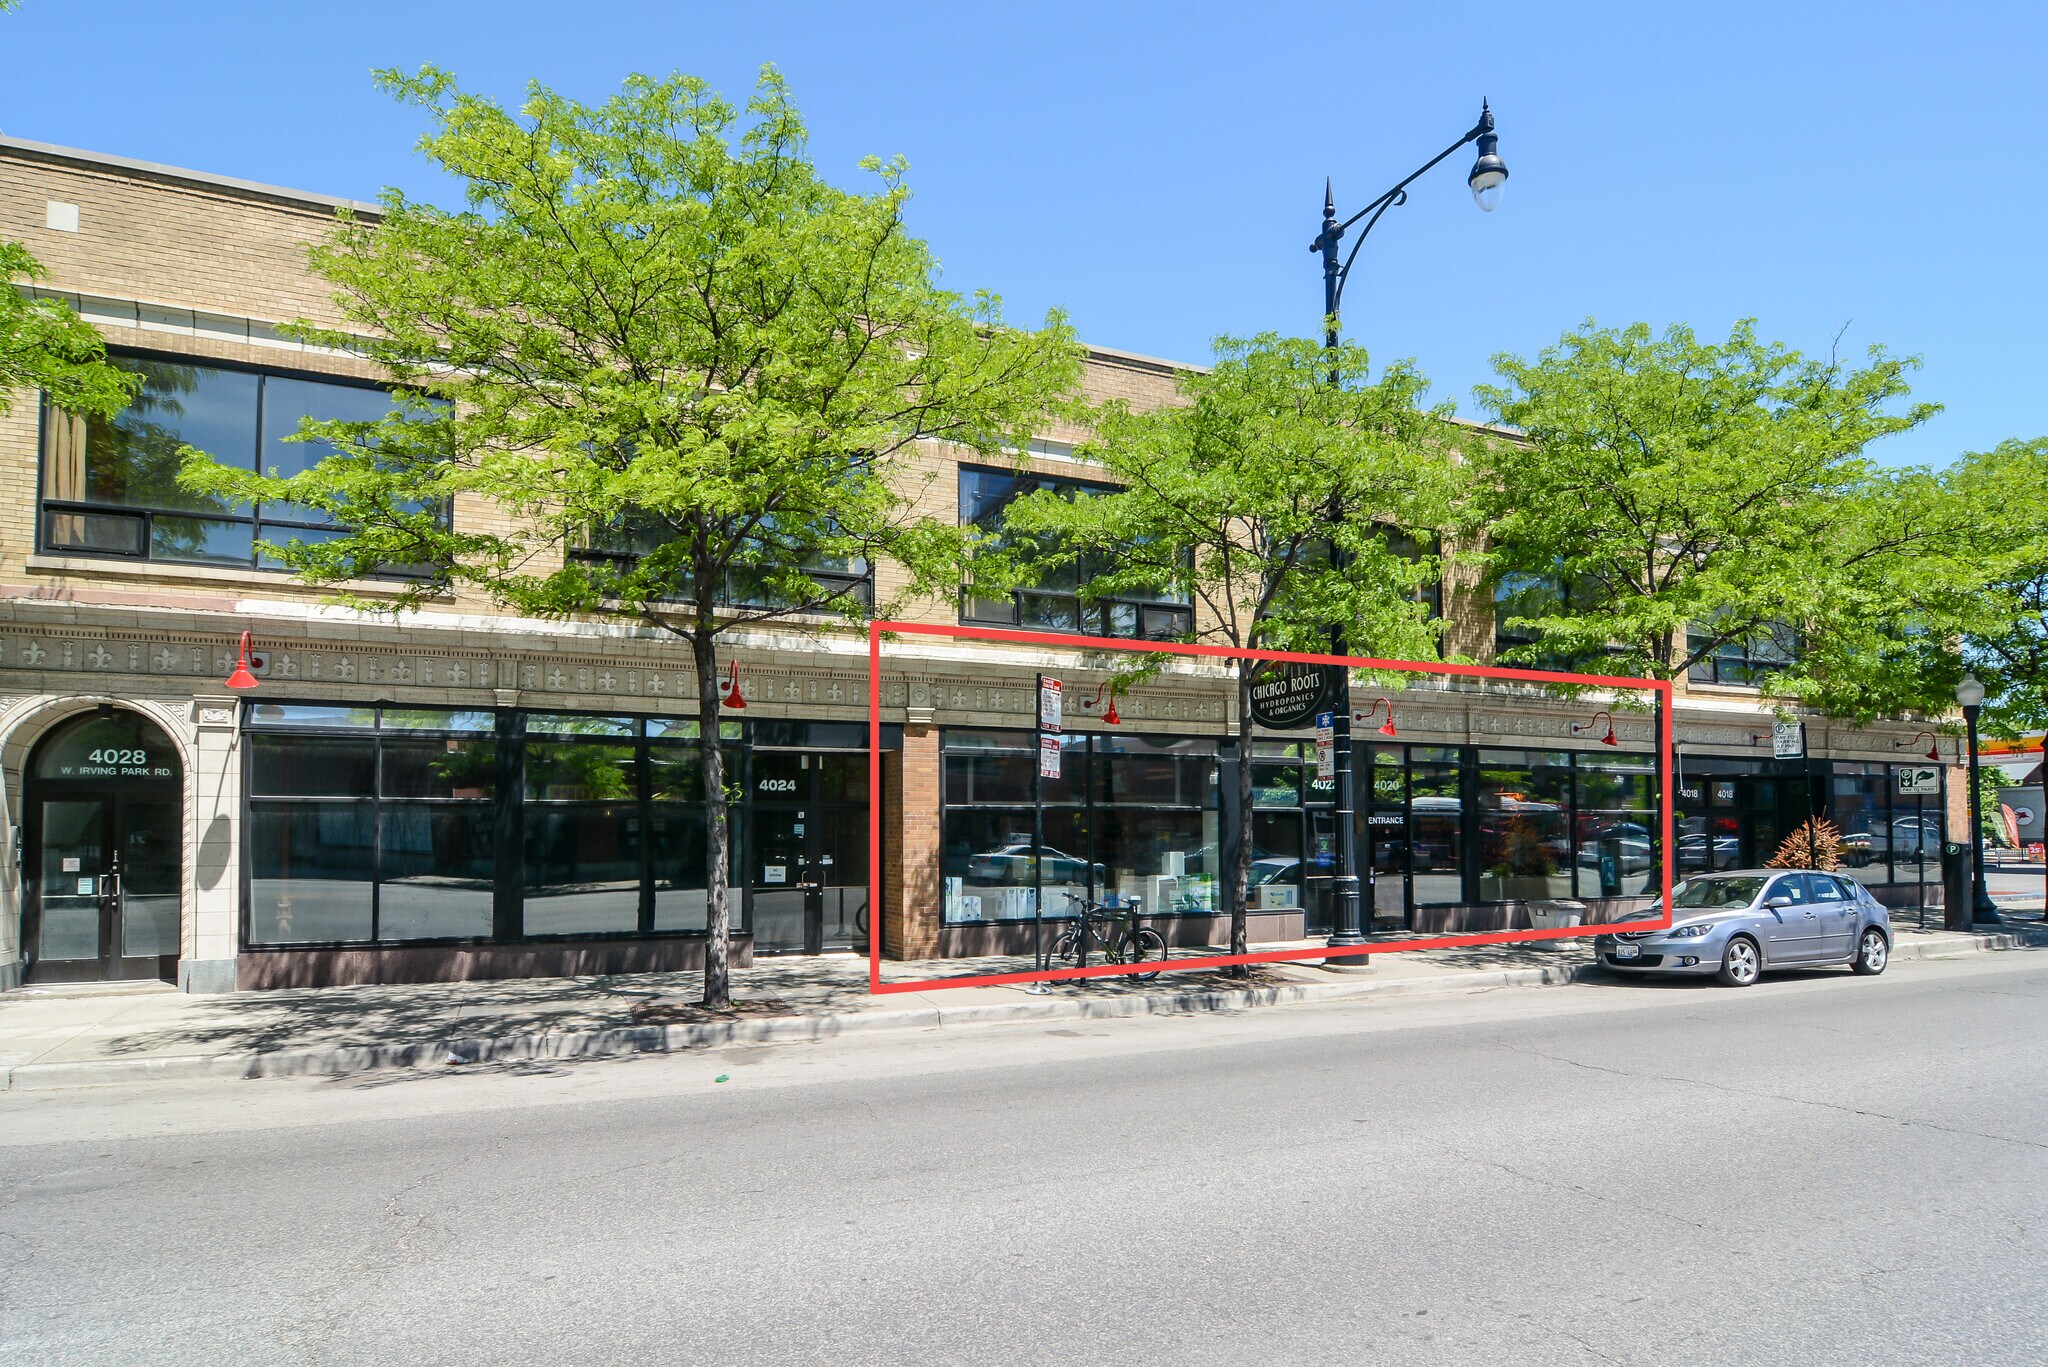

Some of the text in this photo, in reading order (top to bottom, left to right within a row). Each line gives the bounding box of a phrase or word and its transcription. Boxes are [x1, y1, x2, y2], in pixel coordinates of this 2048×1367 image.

[1253, 672, 1320, 700] CHICAGO ROOTS
[1260, 691, 1315, 710] HYDROPONICS
[1274, 702, 1306, 714] ORGANICS
[88, 749, 147, 765] 4028
[61, 766, 173, 777] W. IRVING PARK RD.
[759, 779, 797, 791] 4024
[1311, 778, 1335, 790] 402
[1373, 780, 1399, 791] 4020
[1681, 789, 1698, 798] 4018
[1717, 790, 1733, 798] 4018
[1368, 816, 1404, 825] ENTRANCE
